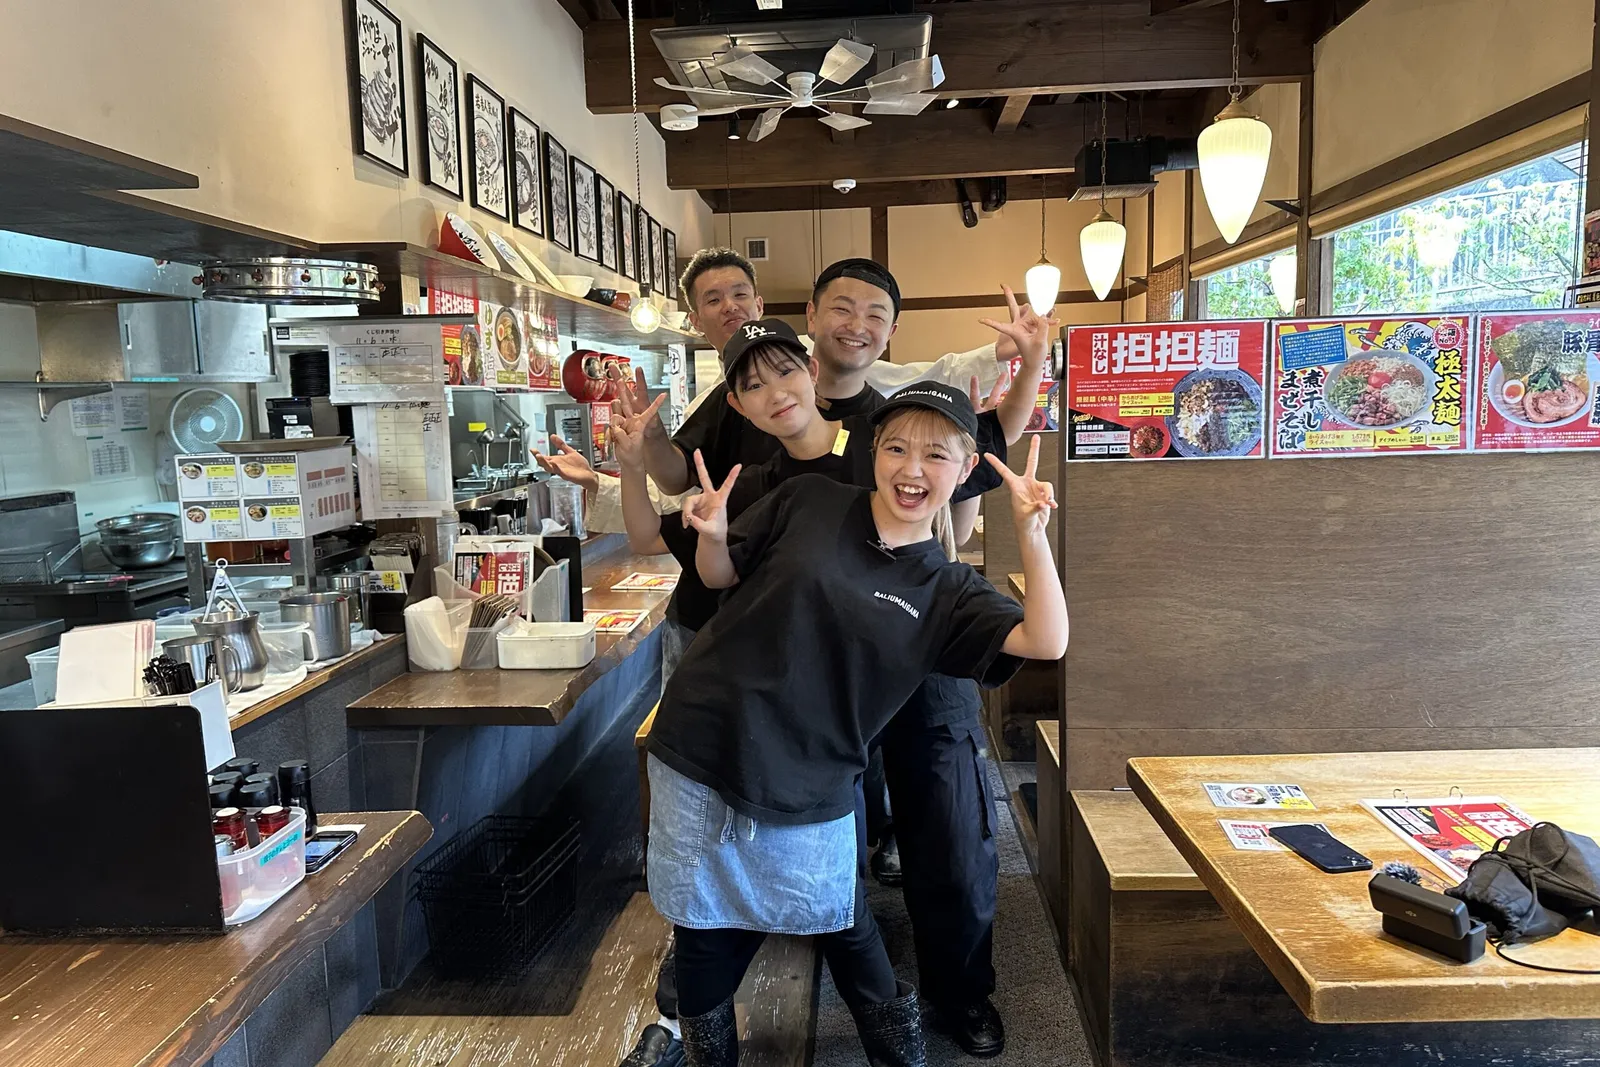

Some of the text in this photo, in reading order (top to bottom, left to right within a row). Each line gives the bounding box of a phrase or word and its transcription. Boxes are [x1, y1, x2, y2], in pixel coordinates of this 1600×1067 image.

[743, 325, 767, 340] LA
[1093, 334, 1108, 373] 汁なし
[1112, 329, 1240, 374] 担担麺
[1280, 371, 1298, 450] まぜそば
[1302, 370, 1323, 429] 煮干し
